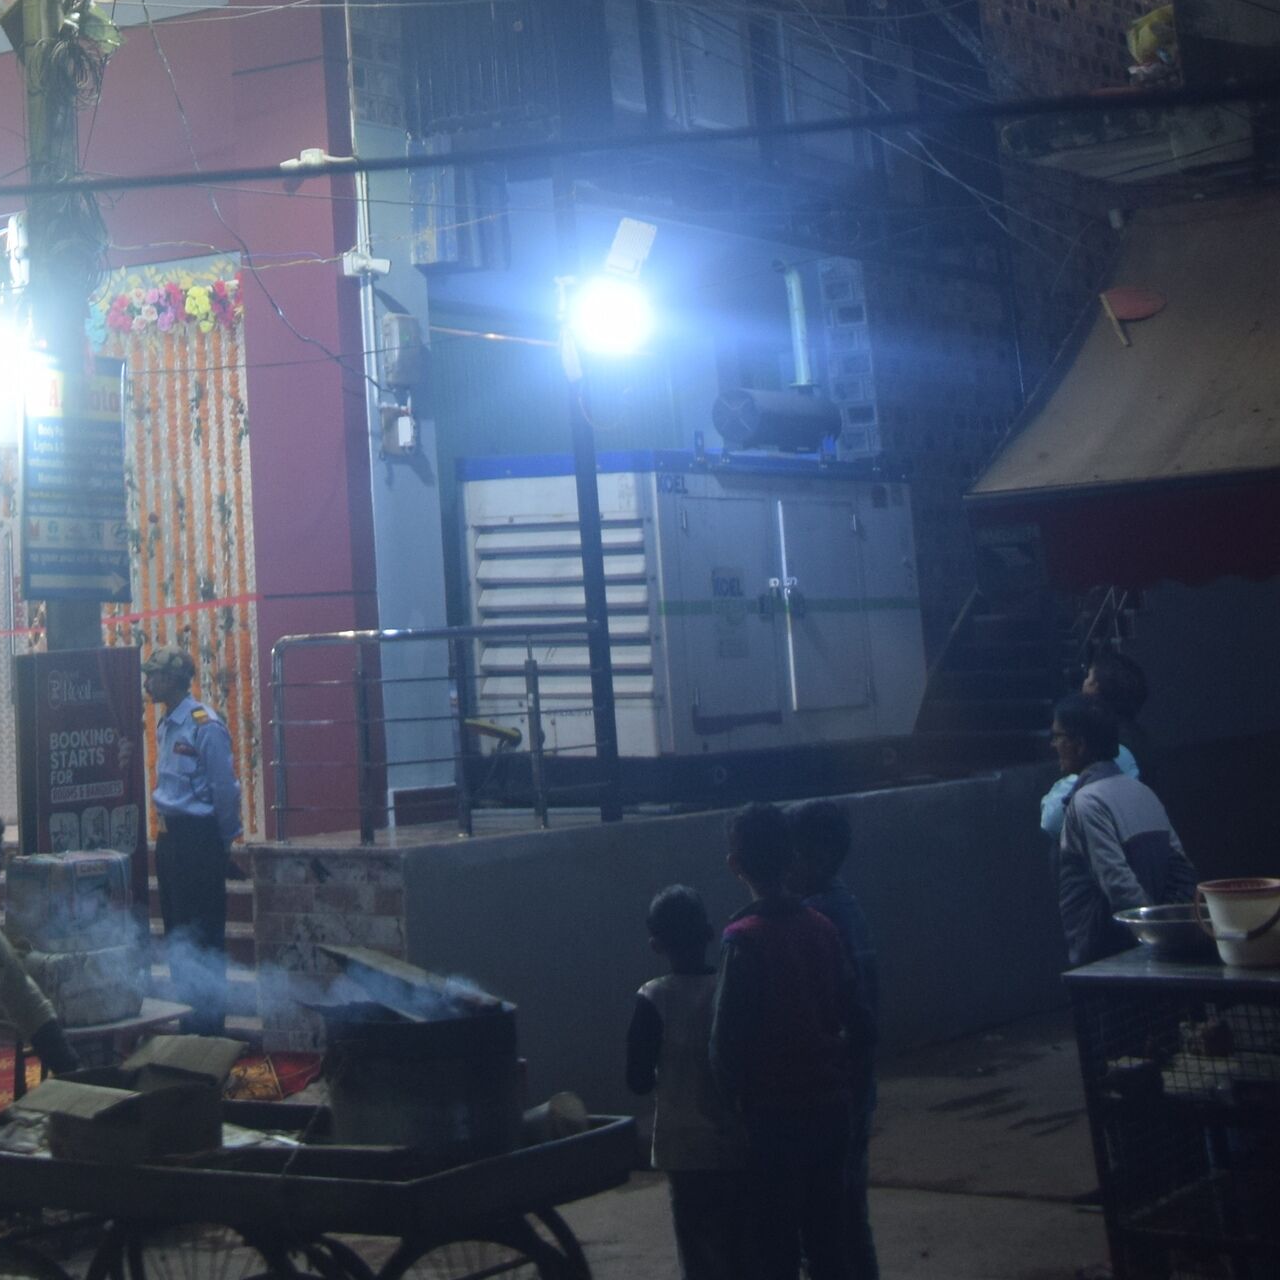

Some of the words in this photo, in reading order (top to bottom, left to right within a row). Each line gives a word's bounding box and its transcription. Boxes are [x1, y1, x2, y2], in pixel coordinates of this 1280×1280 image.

[49, 727, 114, 750] BOOKING
[50, 747, 105, 770] STARTS
[50, 769, 73, 785] FOR
